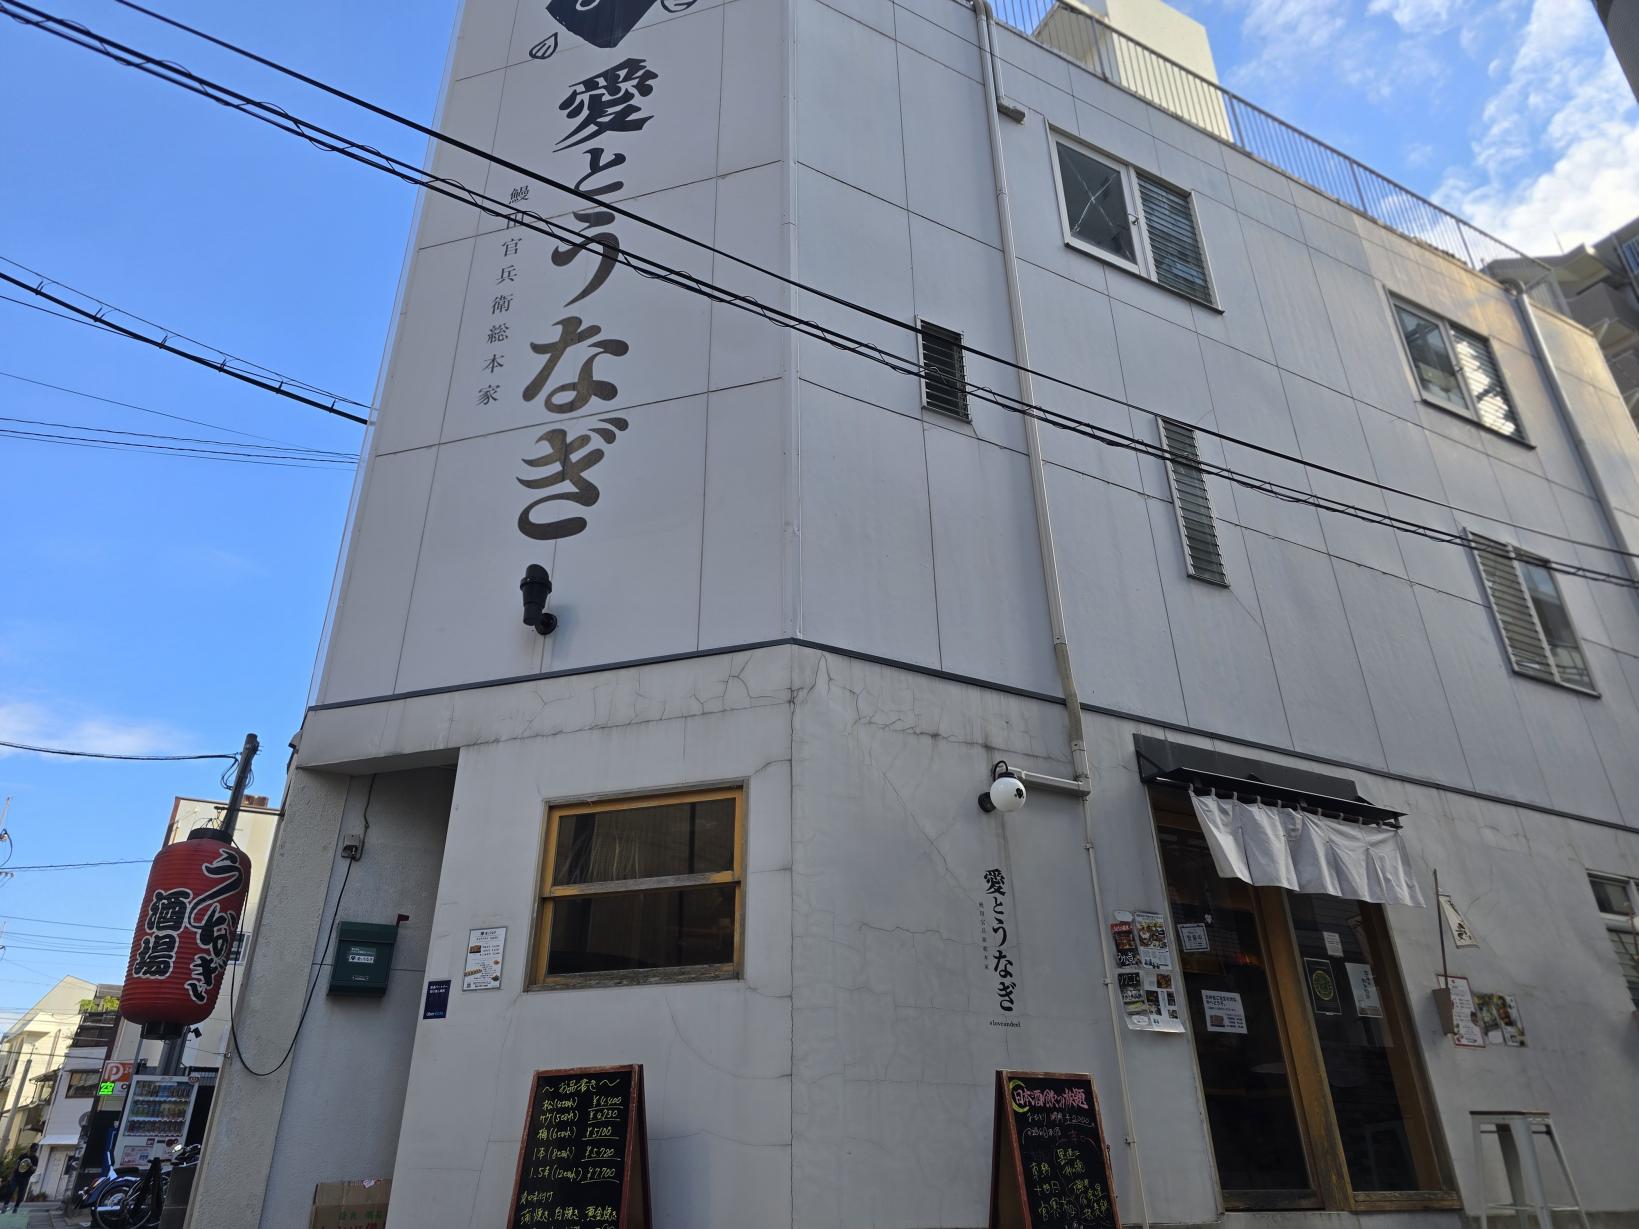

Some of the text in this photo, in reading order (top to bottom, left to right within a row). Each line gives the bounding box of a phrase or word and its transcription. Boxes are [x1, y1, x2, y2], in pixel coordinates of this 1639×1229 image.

[515, 57, 659, 541] 愛とうなぎ
[133, 888, 193, 979] 酒場
[185, 848, 244, 1004] うなぎ
[984, 868, 1017, 1012] 愛とうなぎ
